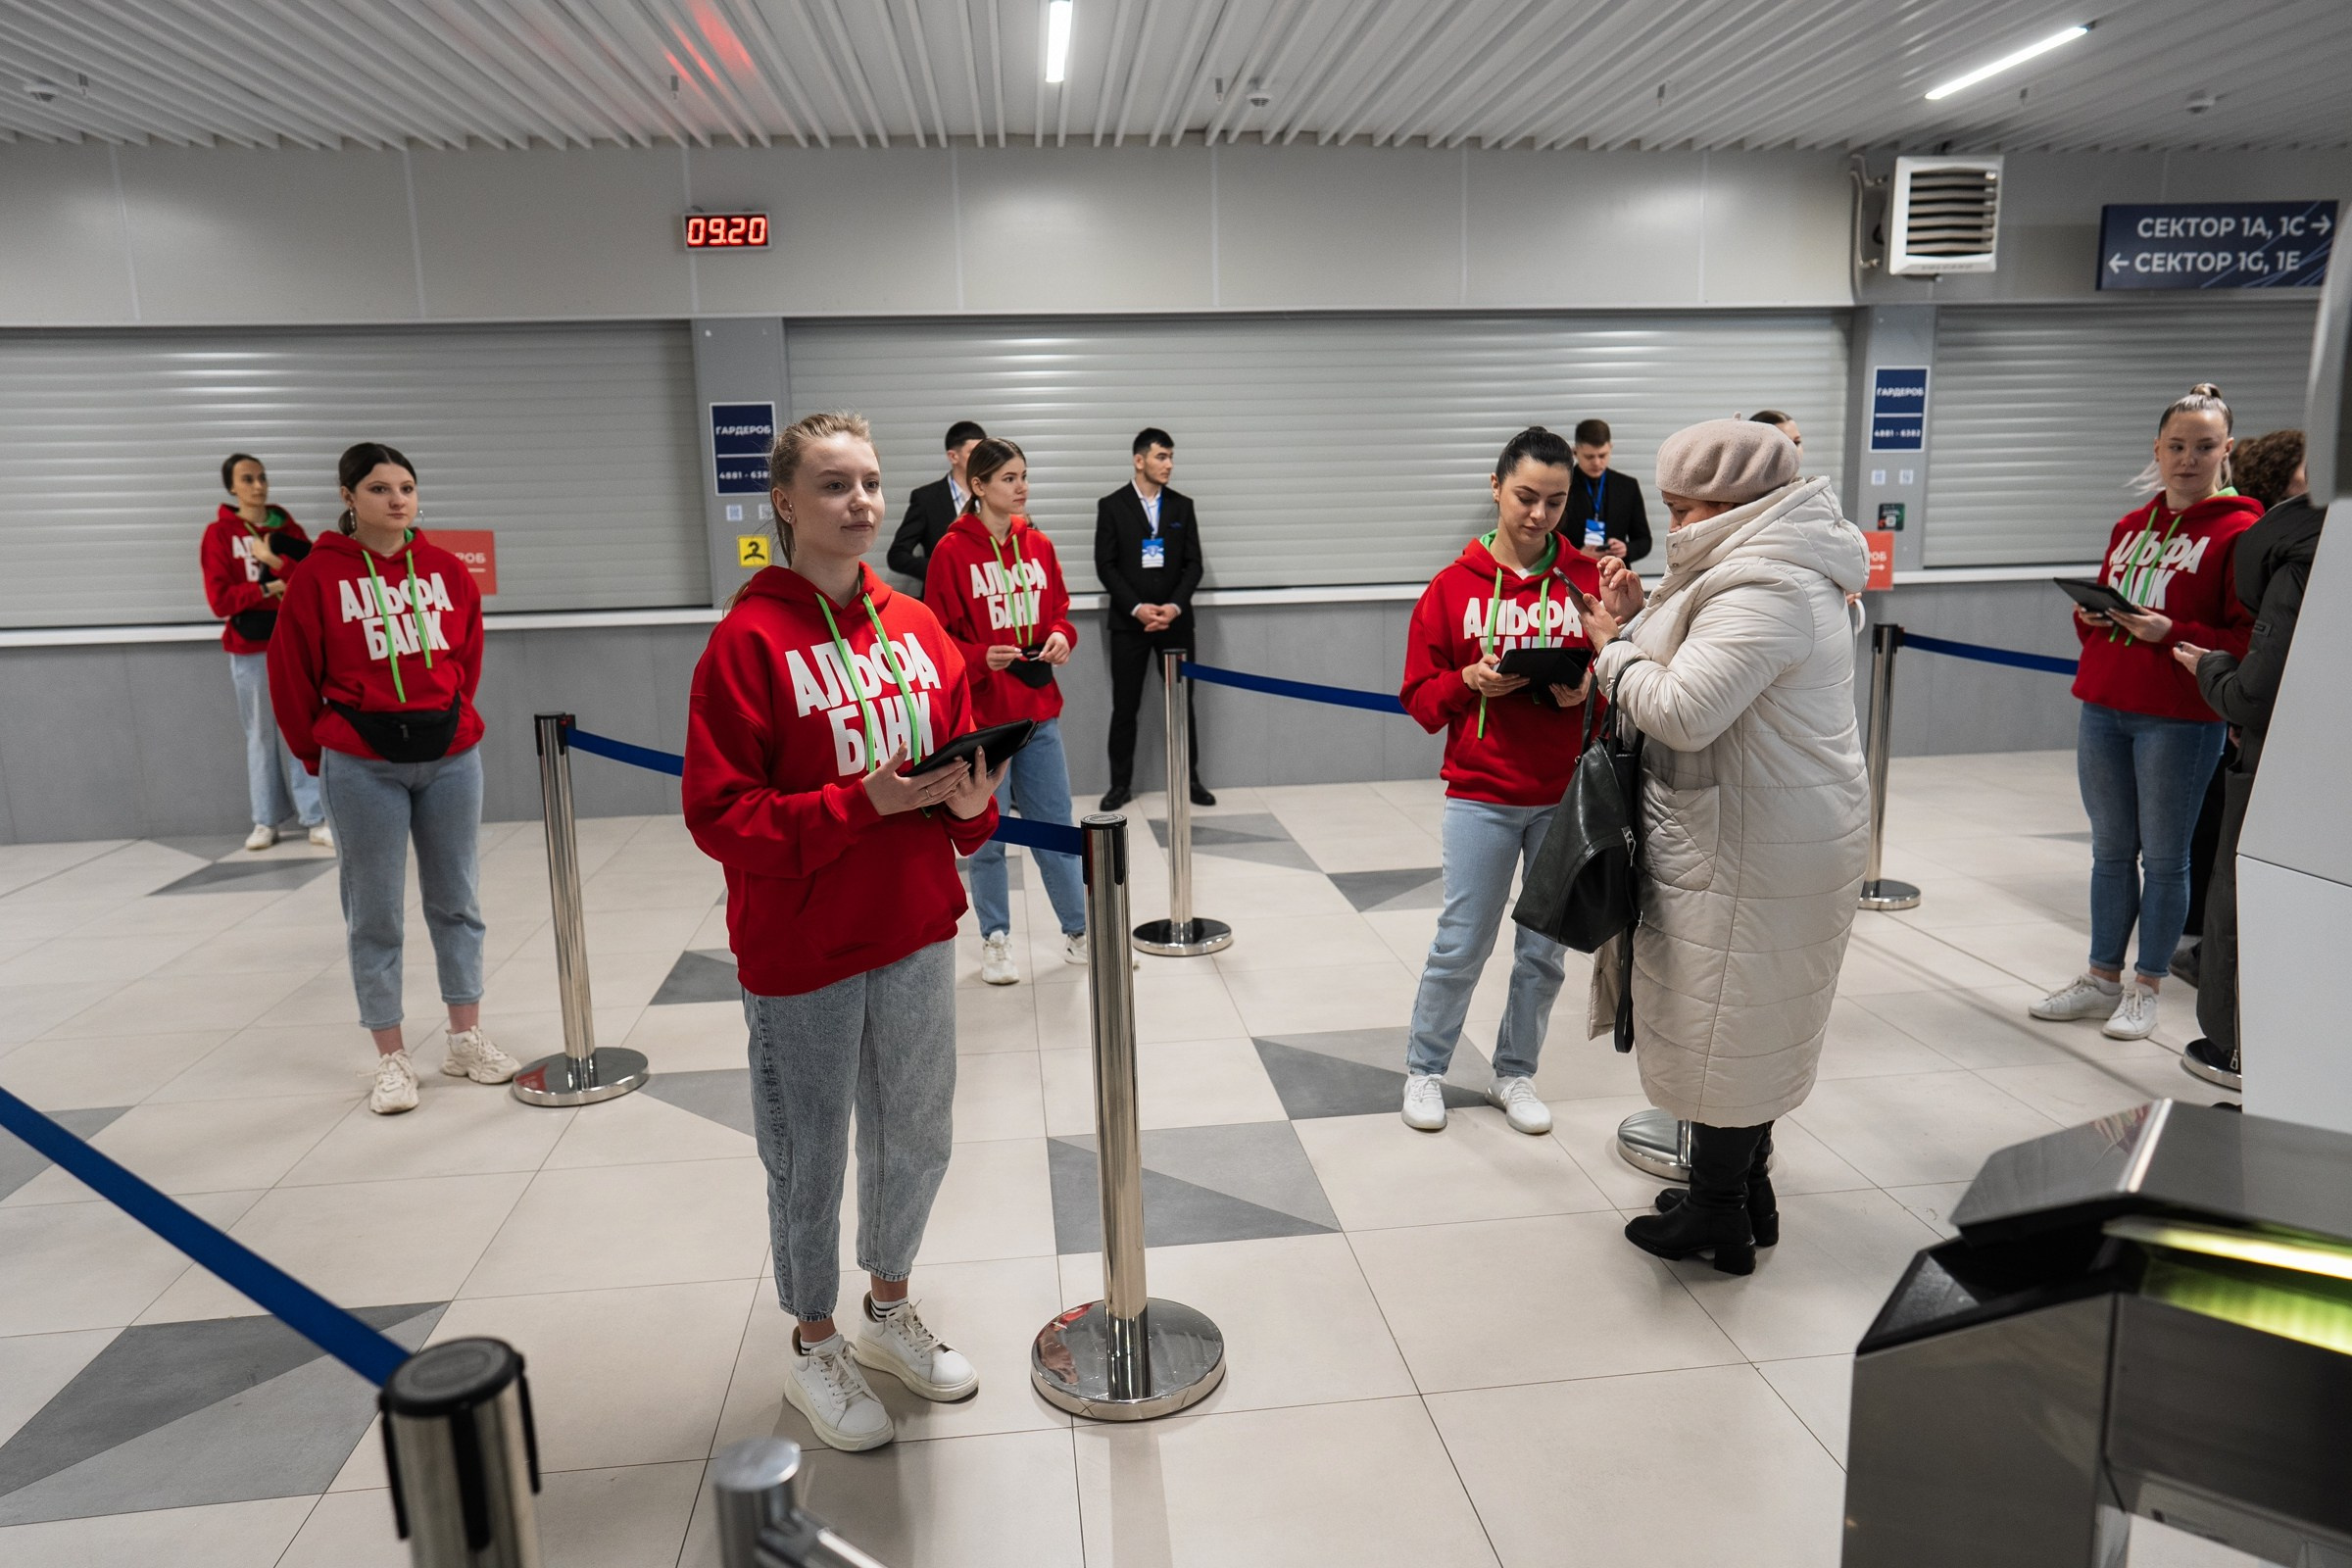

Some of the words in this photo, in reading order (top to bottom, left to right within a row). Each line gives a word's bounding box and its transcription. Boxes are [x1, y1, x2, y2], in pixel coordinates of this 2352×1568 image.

[2137, 217, 2235, 238] СЕКТОР
[2134, 252, 2231, 272] СЕКТОР
[1876, 387, 1924, 397] ГАРДЕРОБ
[715, 425, 771, 436] ГАРДЕРОБ
[751, 470, 772, 479] 638
[338, 572, 454, 623] АЛЬФА
[970, 558, 1047, 599] АЛЬФА
[362, 610, 450, 661] БАНК
[1463, 596, 1583, 639] АЛЬФА
[785, 633, 941, 718] АЛЬФА
[827, 691, 934, 776] БАНК
